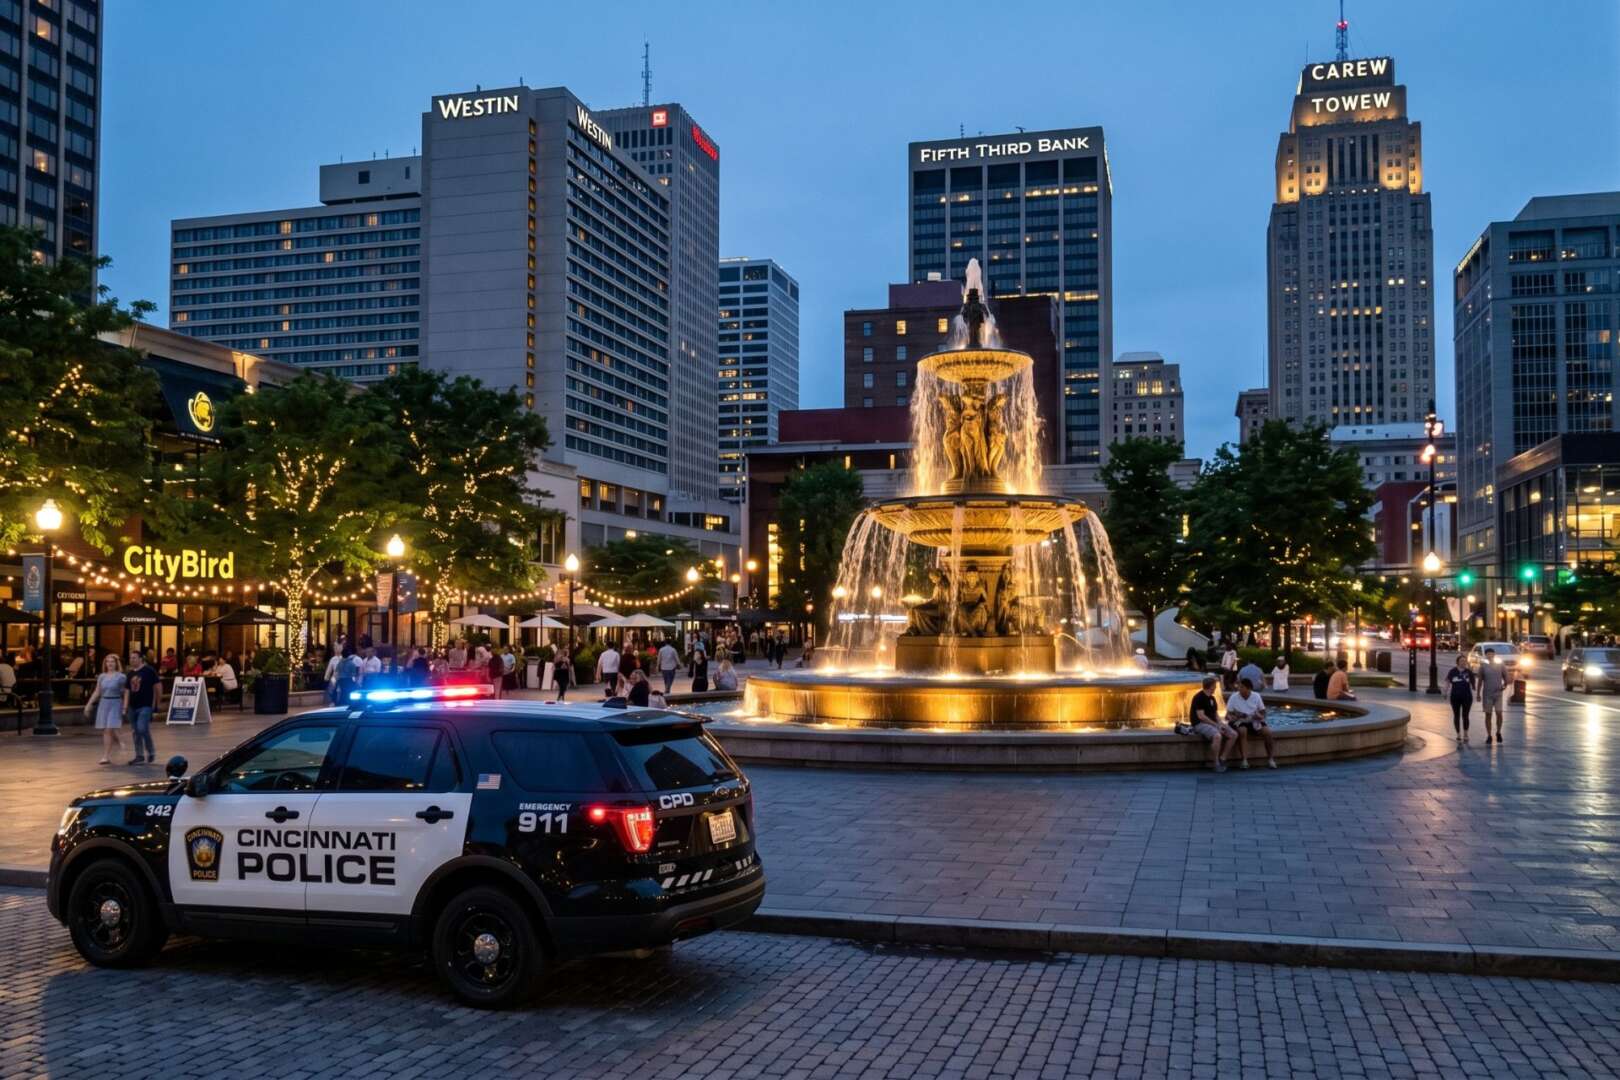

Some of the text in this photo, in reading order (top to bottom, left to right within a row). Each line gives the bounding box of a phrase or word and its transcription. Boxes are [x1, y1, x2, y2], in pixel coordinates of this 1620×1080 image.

[1312, 59, 1388, 80] CAREW
[438, 95, 519, 119] WESTIN
[1311, 92, 1391, 113] TOWEW
[576, 105, 612, 150] WESTIN
[920, 137, 1089, 163] FIFTH THIRD BANK
[123, 546, 235, 583] CityBird
[145, 805, 172, 817] 342
[518, 803, 572, 812] EMERGENCY
[660, 793, 694, 809] CPD
[517, 812, 568, 834] 911
[237, 829, 396, 850] CINCINNATI
[193, 870, 217, 880] POLICE
[237, 852, 396, 886] POLICE
